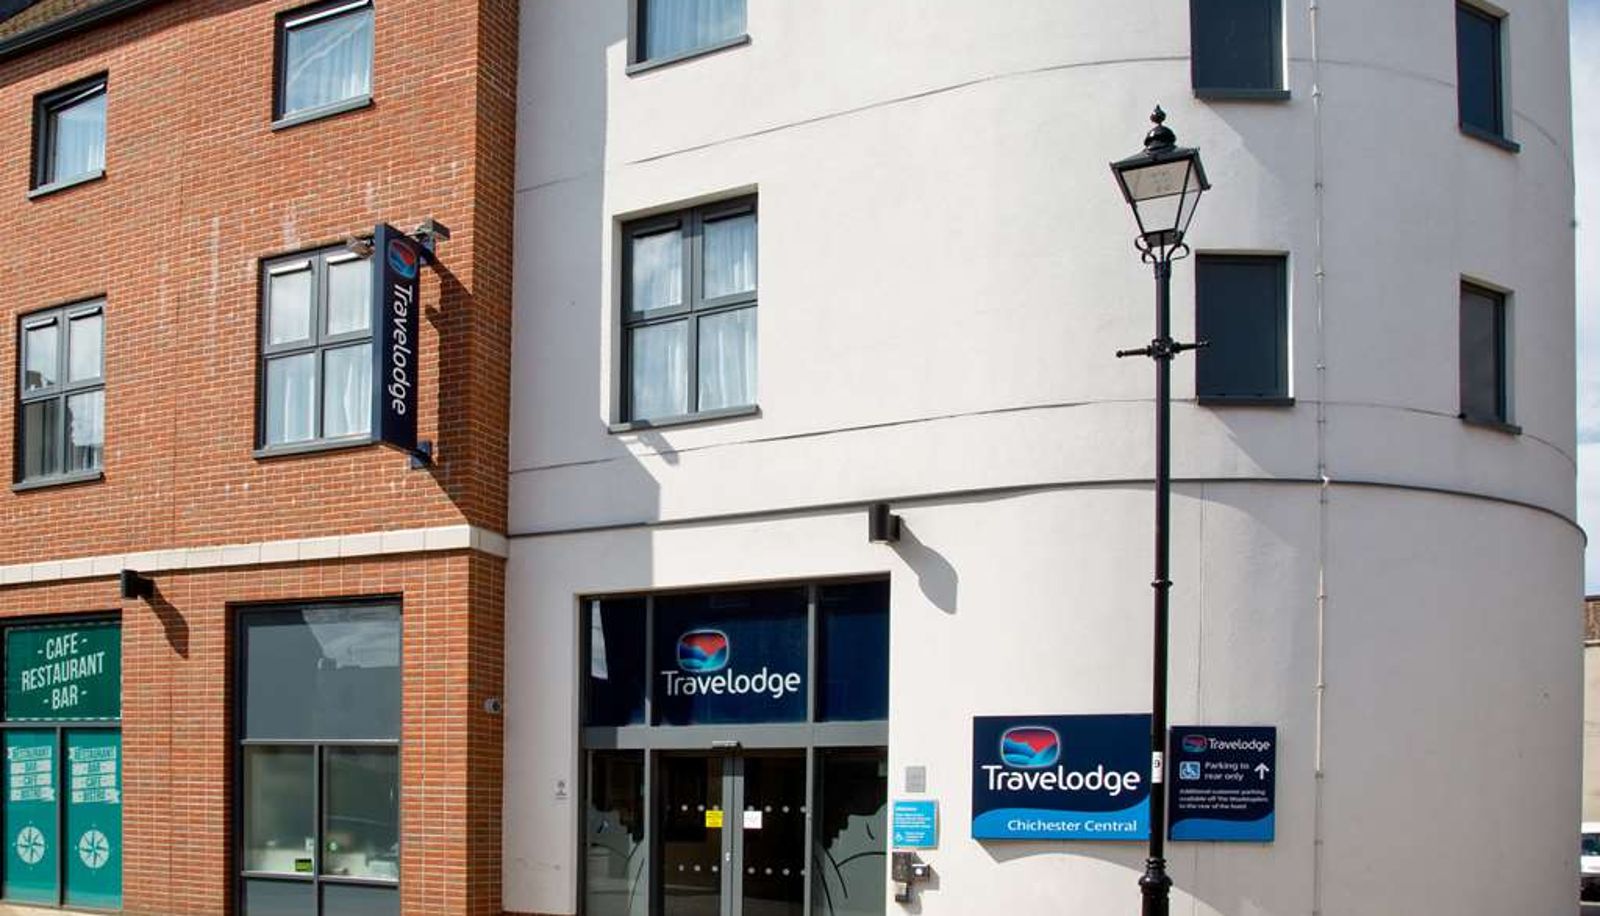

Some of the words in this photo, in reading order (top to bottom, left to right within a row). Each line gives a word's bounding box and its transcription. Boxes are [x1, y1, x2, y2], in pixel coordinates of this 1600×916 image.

[389, 284, 413, 416] Travelodge
[46, 632, 79, 660] CAFE
[21, 650, 105, 692] RESTAURANT
[661, 666, 801, 699] Travelodge
[52, 684, 78, 710] BAR
[1208, 738, 1271, 752] Travelodge
[982, 764, 1141, 796] Travelodge
[1204, 762, 1239, 771] Parking
[1240, 762, 1250, 770] to
[1224, 772, 1244, 781] only
[1007, 819, 1081, 832] Chichester
[1084, 819, 1137, 832] Central
